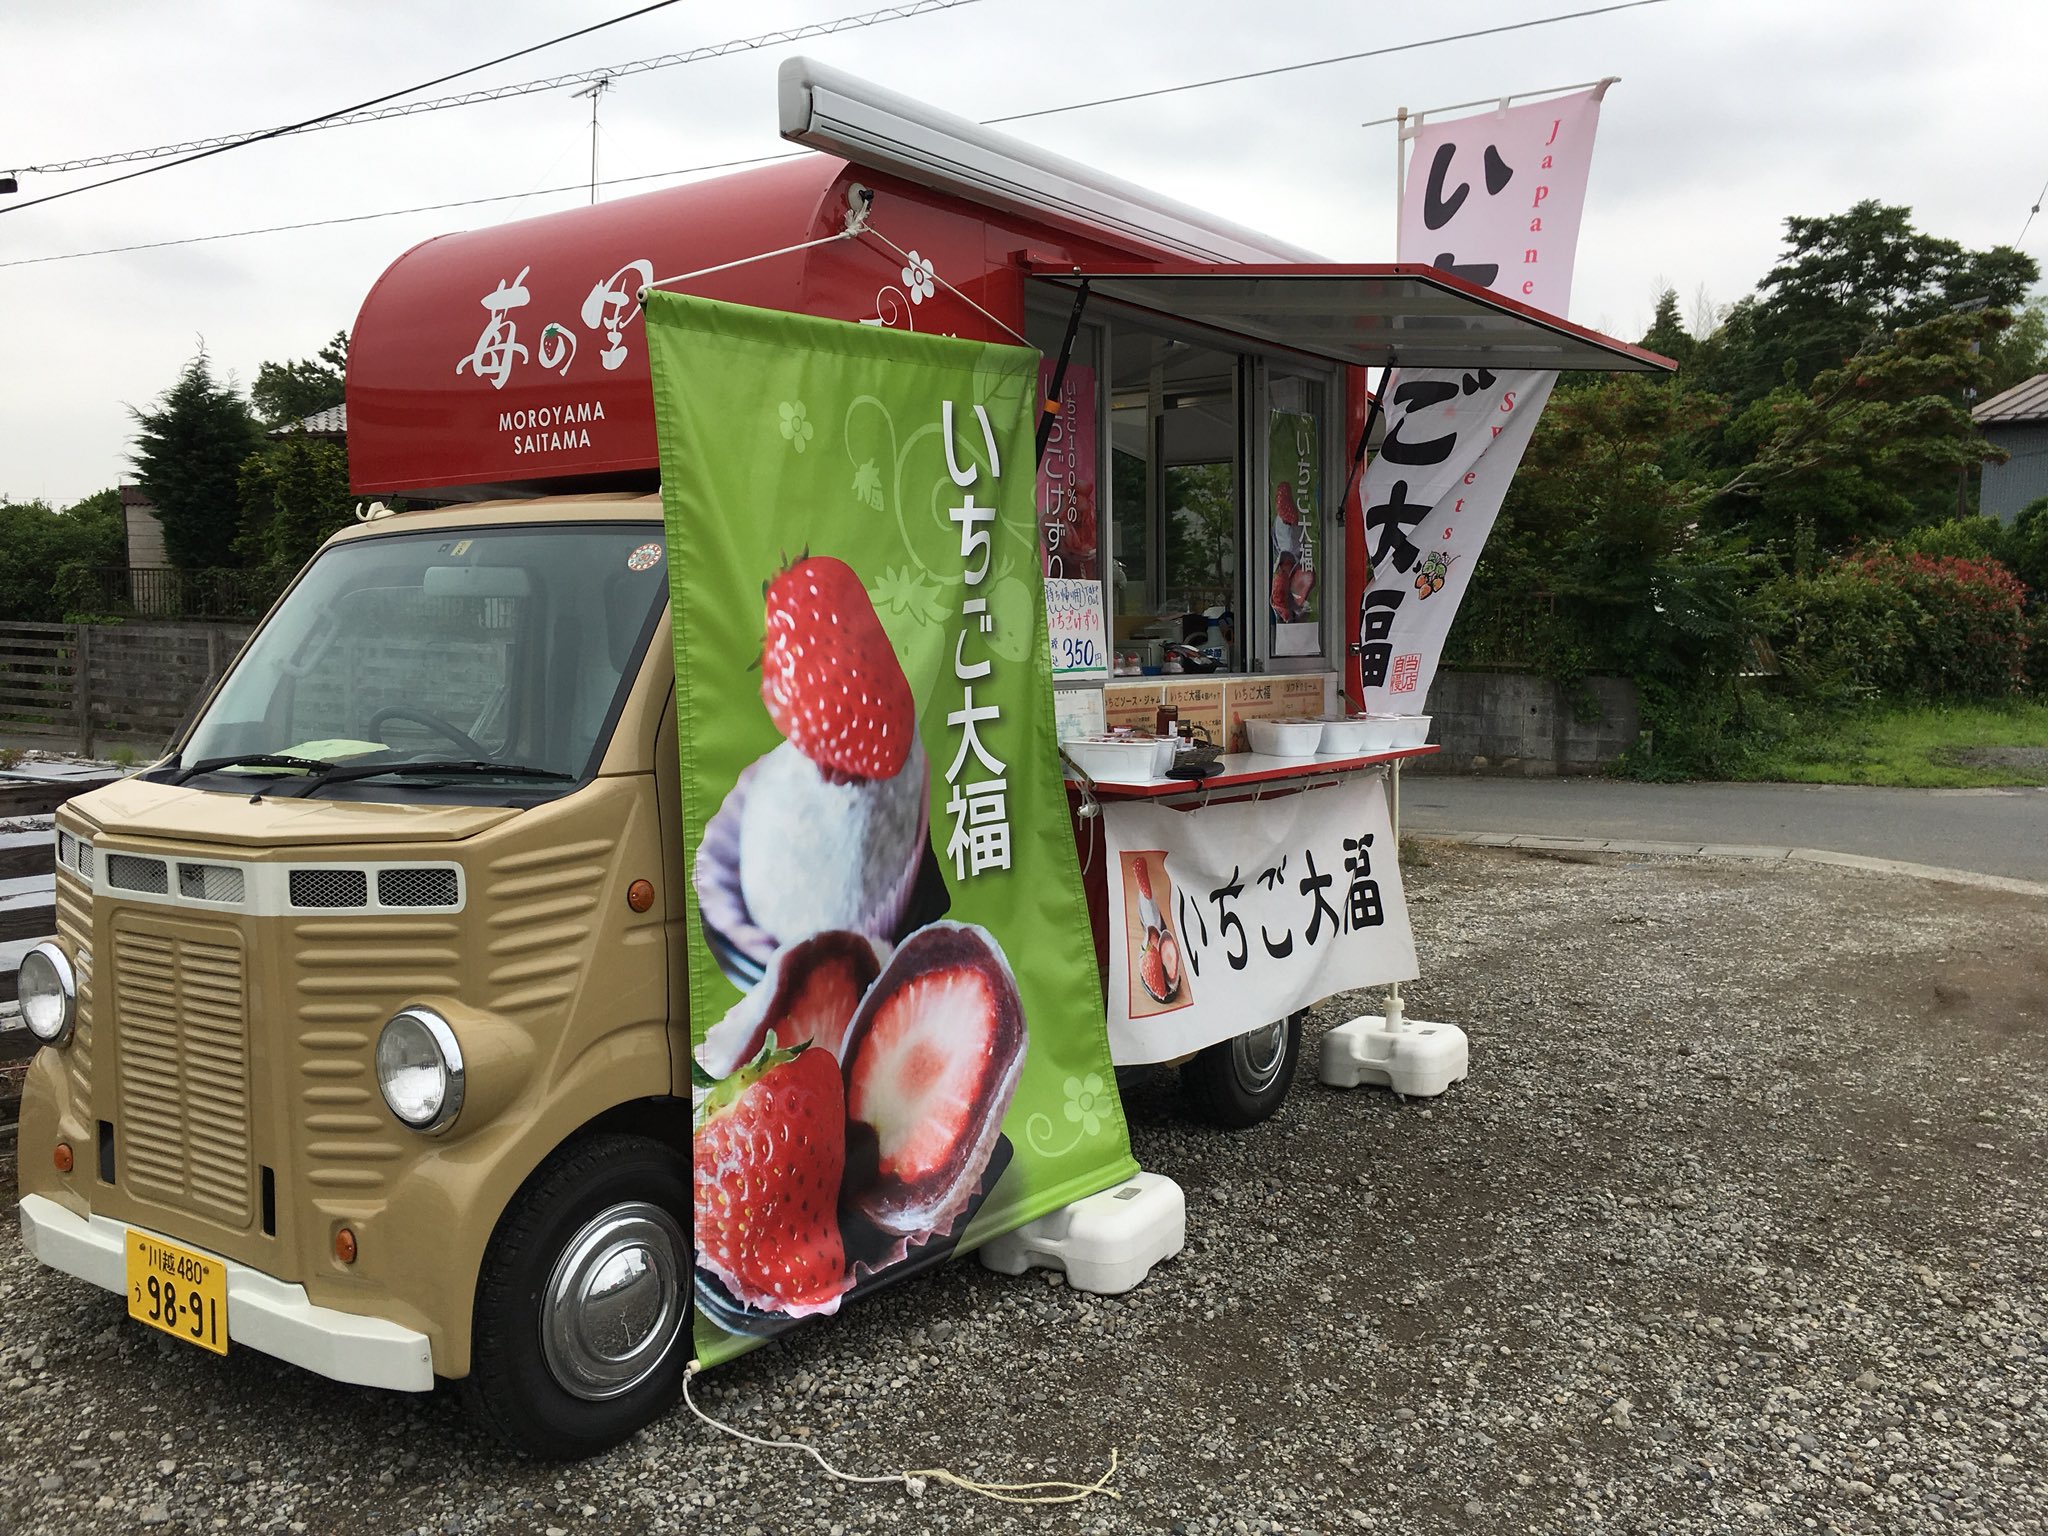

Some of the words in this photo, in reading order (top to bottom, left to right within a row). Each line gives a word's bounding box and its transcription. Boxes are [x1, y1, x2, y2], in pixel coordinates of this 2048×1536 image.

[1522, 119, 1562, 295] Japane
[498, 400, 606, 432] MOROYAMA
[514, 428, 592, 455] SAITAMA
[1296, 430, 1314, 573] いちご大福
[941, 400, 1012, 882] いちご大福
[1235, 685, 1271, 701] いちご大福
[1177, 833, 1384, 977] いちご大福
[134, 1281, 141, 1303] う
[147, 1275, 217, 1345] 98-91
